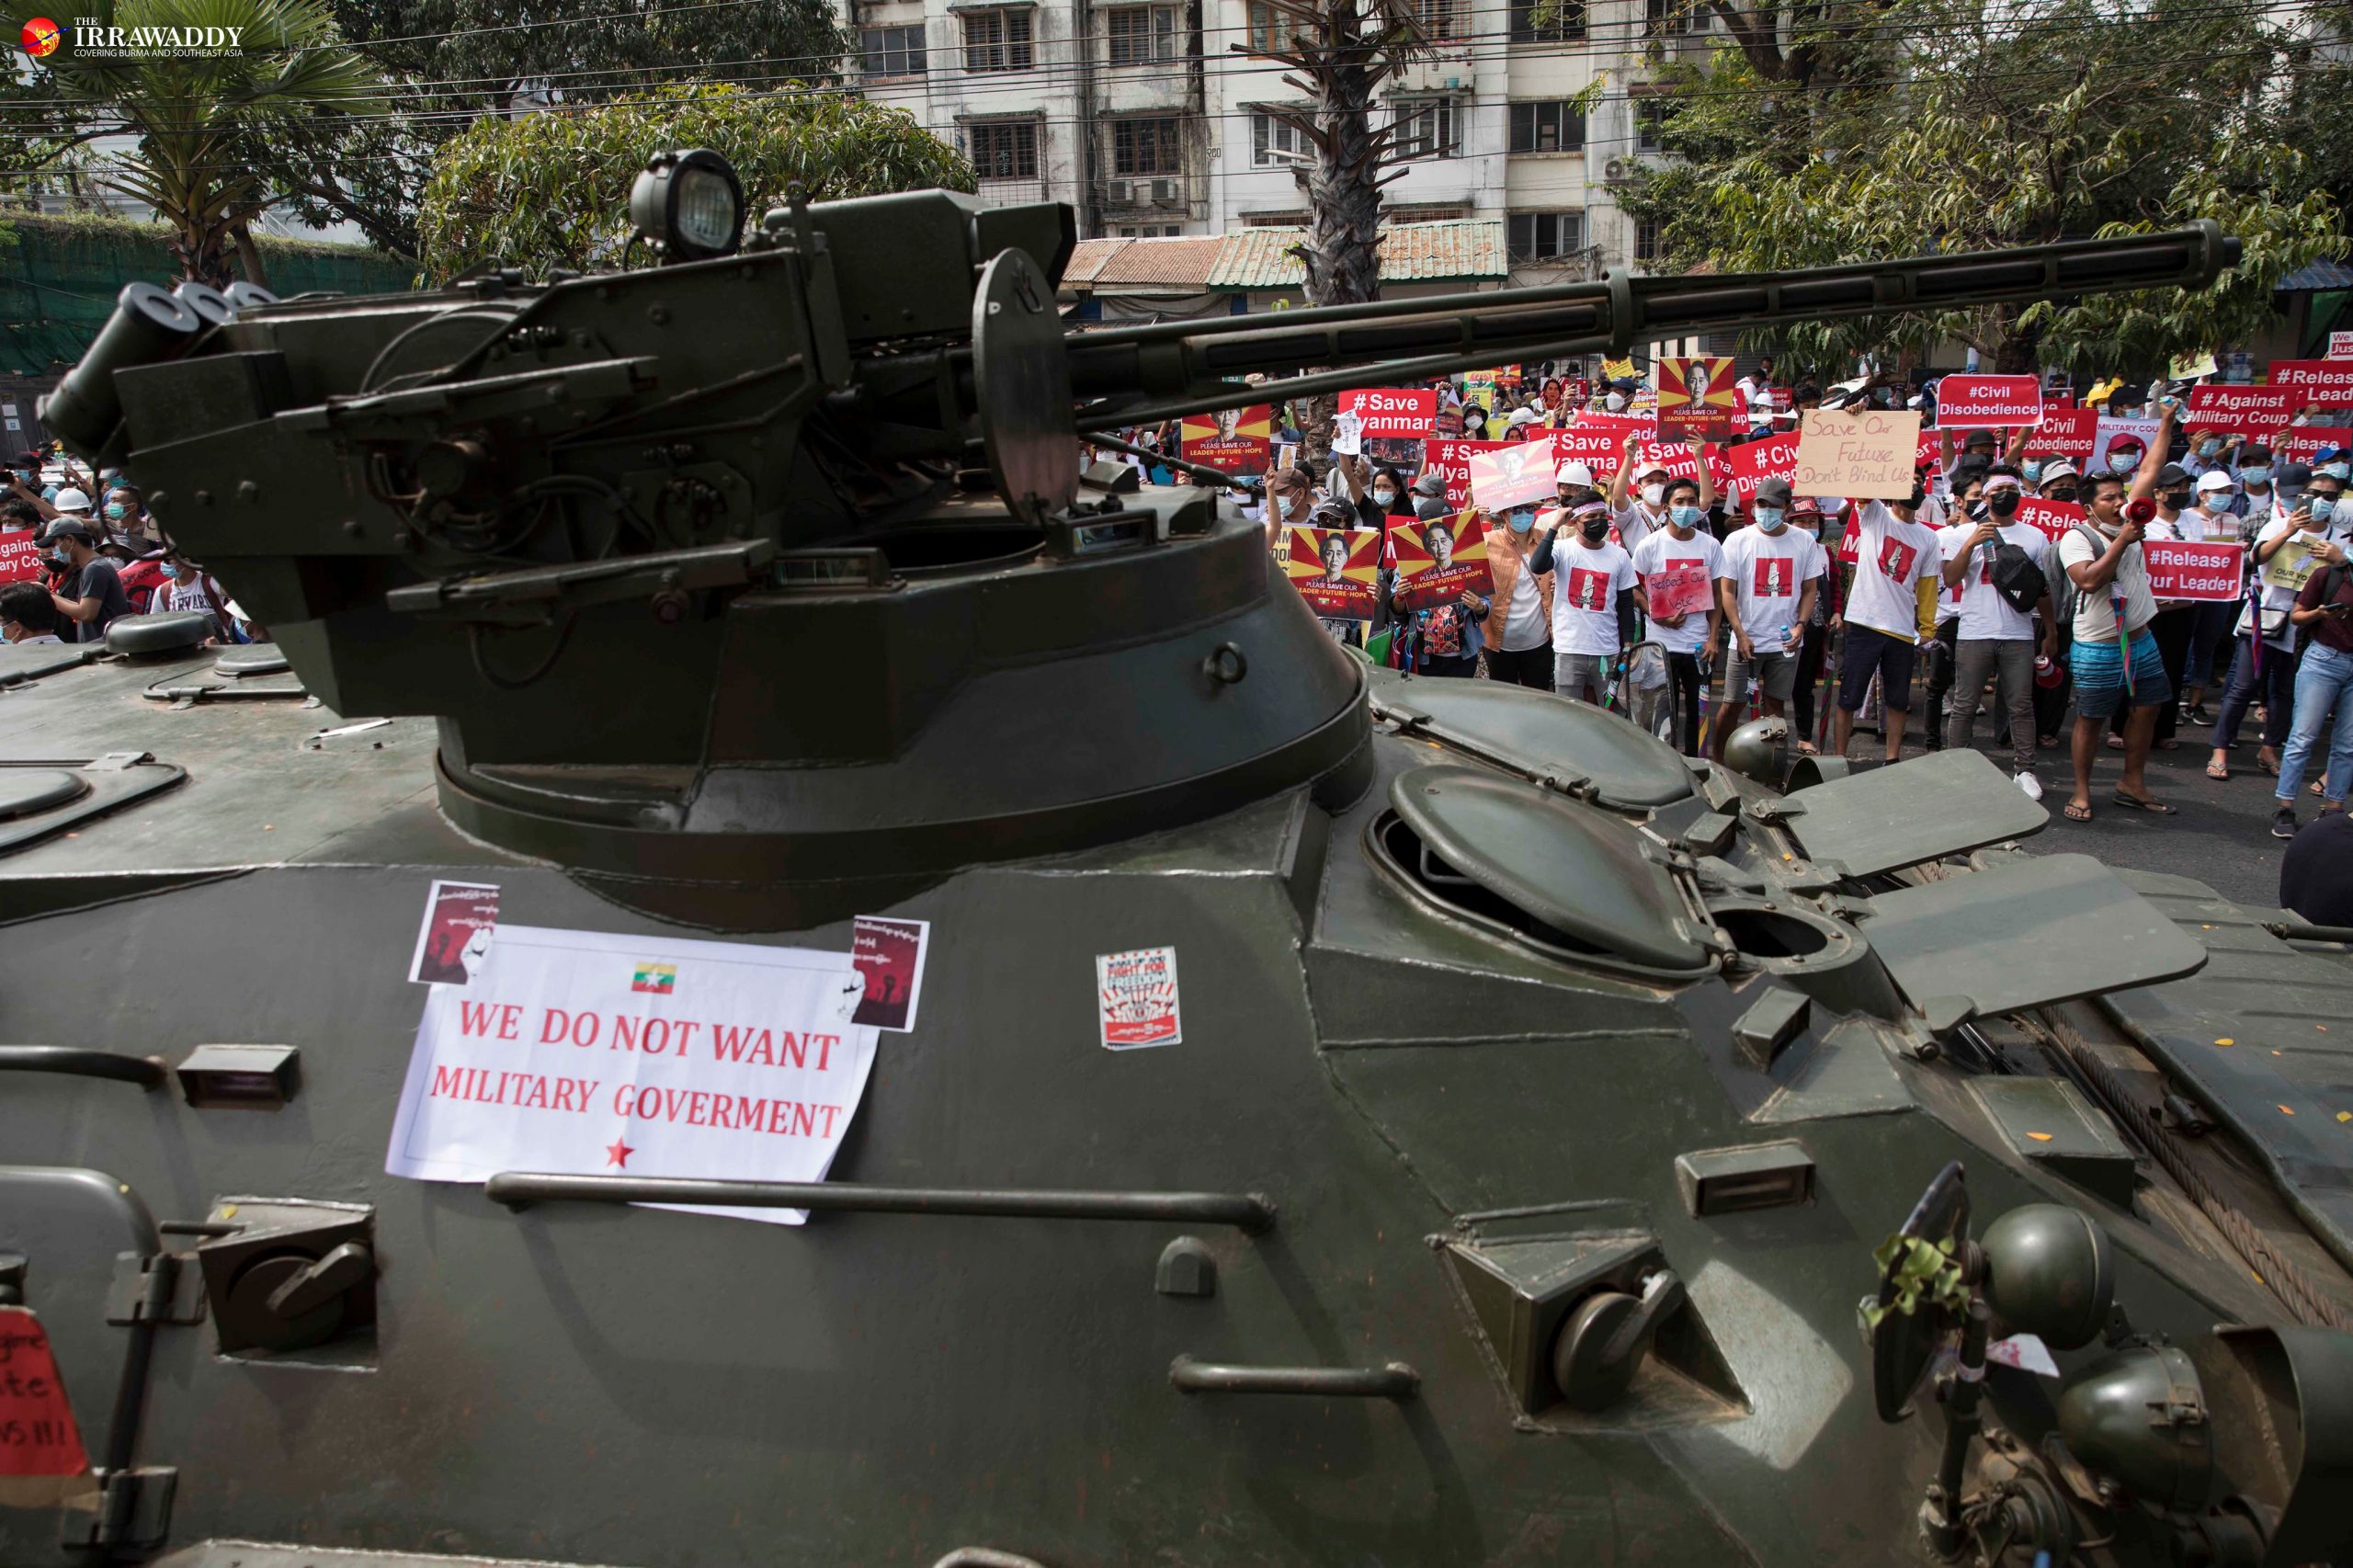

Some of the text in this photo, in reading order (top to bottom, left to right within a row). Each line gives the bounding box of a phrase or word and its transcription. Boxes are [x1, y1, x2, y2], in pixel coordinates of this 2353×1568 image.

[2332, 344, 2353, 354] Jus
[2277, 369, 2353, 384] #Releas
[1969, 386, 2011, 398] #Civil
[2307, 387, 2353, 402] Lead
[1939, 403, 2039, 415] Disobedience
[1360, 416, 1433, 430] yanmar
[1805, 414, 1892, 437] Save Our
[2188, 410, 2290, 426] Military Coup
[2098, 424, 2137, 432] MILITARY
[1838, 442, 1893, 462] Future
[1798, 466, 1909, 483] Don't Blind Us
[0, 540, 37, 557] gains
[2150, 551, 2231, 568] #Release
[1419, 565, 1472, 582] PLEASE SAVE OUR
[1438, 574, 1462, 585] FUTURE
[1465, 569, 1483, 578] HOPE
[2276, 568, 2294, 577] OUR
[1651, 574, 1685, 589] Respect
[2179, 574, 2235, 591] Leader
[171, 594, 212, 612] ARVARD
[459, 1000, 840, 1071] WE DO NOT WANT
[430, 1066, 842, 1139] MILITARY GOVERMENT
